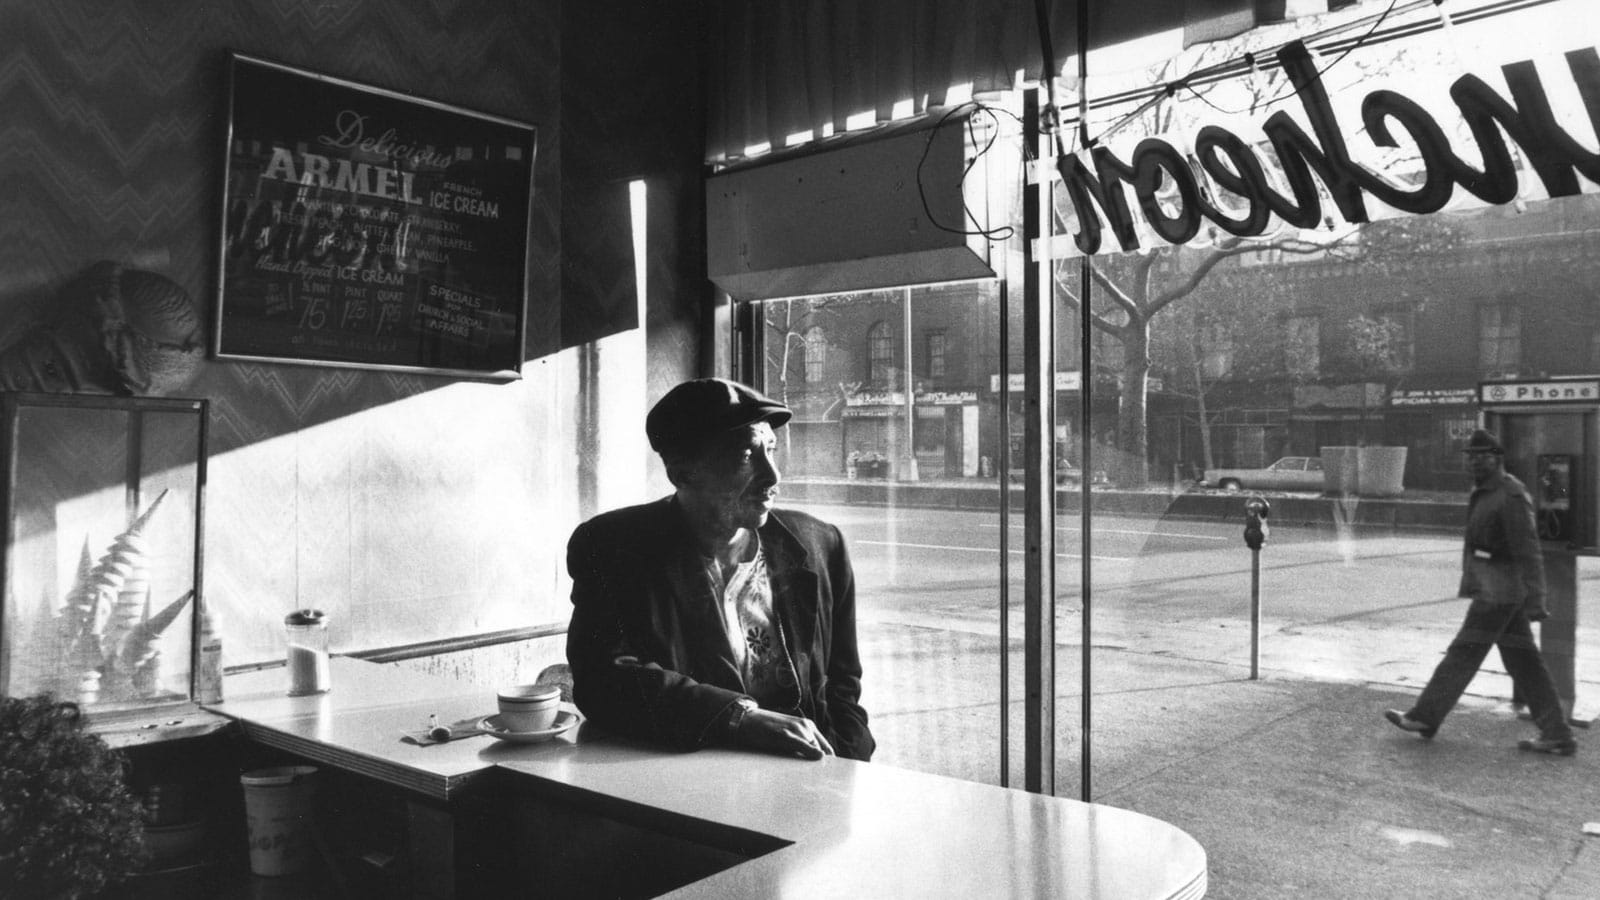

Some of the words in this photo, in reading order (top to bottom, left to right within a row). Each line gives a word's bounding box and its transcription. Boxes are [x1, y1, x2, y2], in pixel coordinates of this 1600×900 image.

[317, 109, 452, 169] Delicious
[260, 146, 424, 205] ARMEL
[429, 190, 452, 211] ICE
[453, 195, 499, 219] CREAM
[337, 265, 358, 281] ICE
[361, 269, 405, 286] CREAM
[344, 286, 368, 298] PINT
[429, 284, 482, 309] SPECIALS
[1517, 386, 1590, 398] Phone
